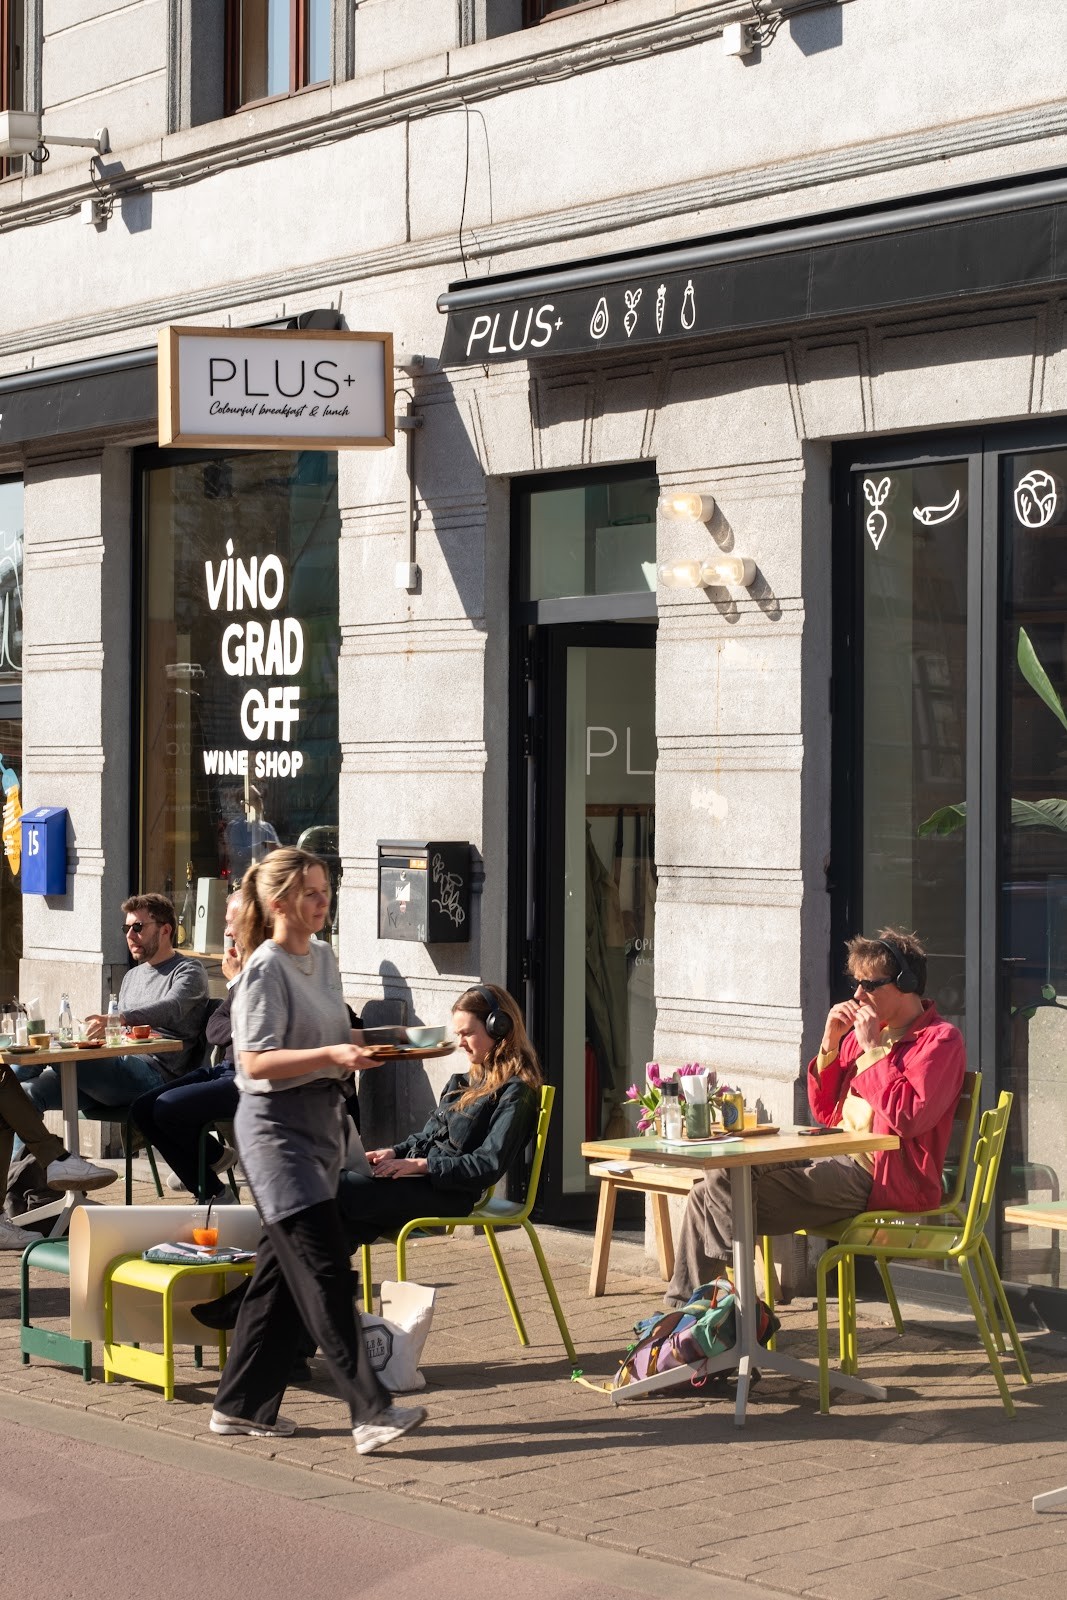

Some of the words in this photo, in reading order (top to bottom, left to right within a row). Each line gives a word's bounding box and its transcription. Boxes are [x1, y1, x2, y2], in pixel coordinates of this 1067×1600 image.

[466, 304, 563, 356] PLUS+
[209, 358, 356, 398] PLUS+
[209, 400, 259, 417] Colourful
[258, 403, 308, 418] breakfast
[308, 405, 320, 417] &
[322, 404, 352, 417] lunch
[221, 617, 304, 676] GRAD
[203, 750, 249, 775] WINE
[254, 750, 304, 778] SHOP
[28, 829, 39, 856] 15
